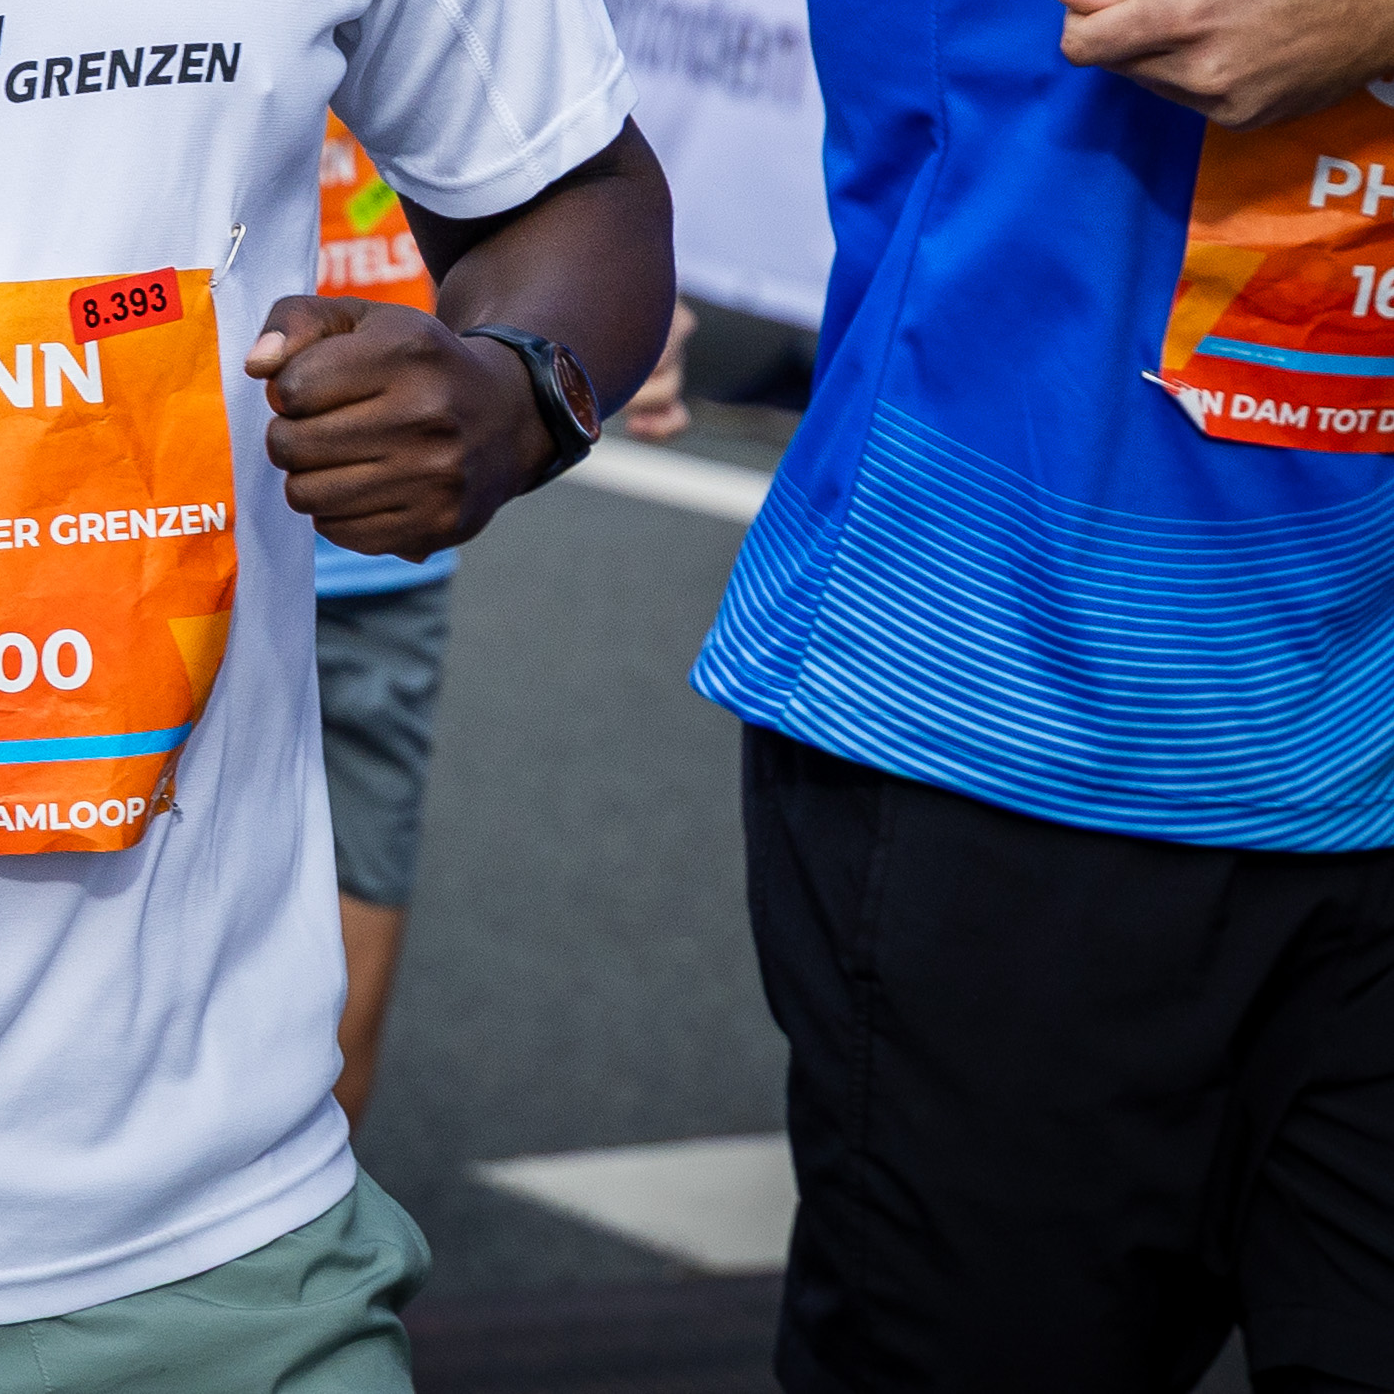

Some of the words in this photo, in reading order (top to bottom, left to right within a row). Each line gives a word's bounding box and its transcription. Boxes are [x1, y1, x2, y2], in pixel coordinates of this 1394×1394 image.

[4, 41, 243, 104] GRENZEN
[82, 282, 168, 330] 8.393
[1229, 392, 1311, 430] DAM
[1315, 406, 1376, 434] TOT
[49, 501, 227, 546] GRENZEN
